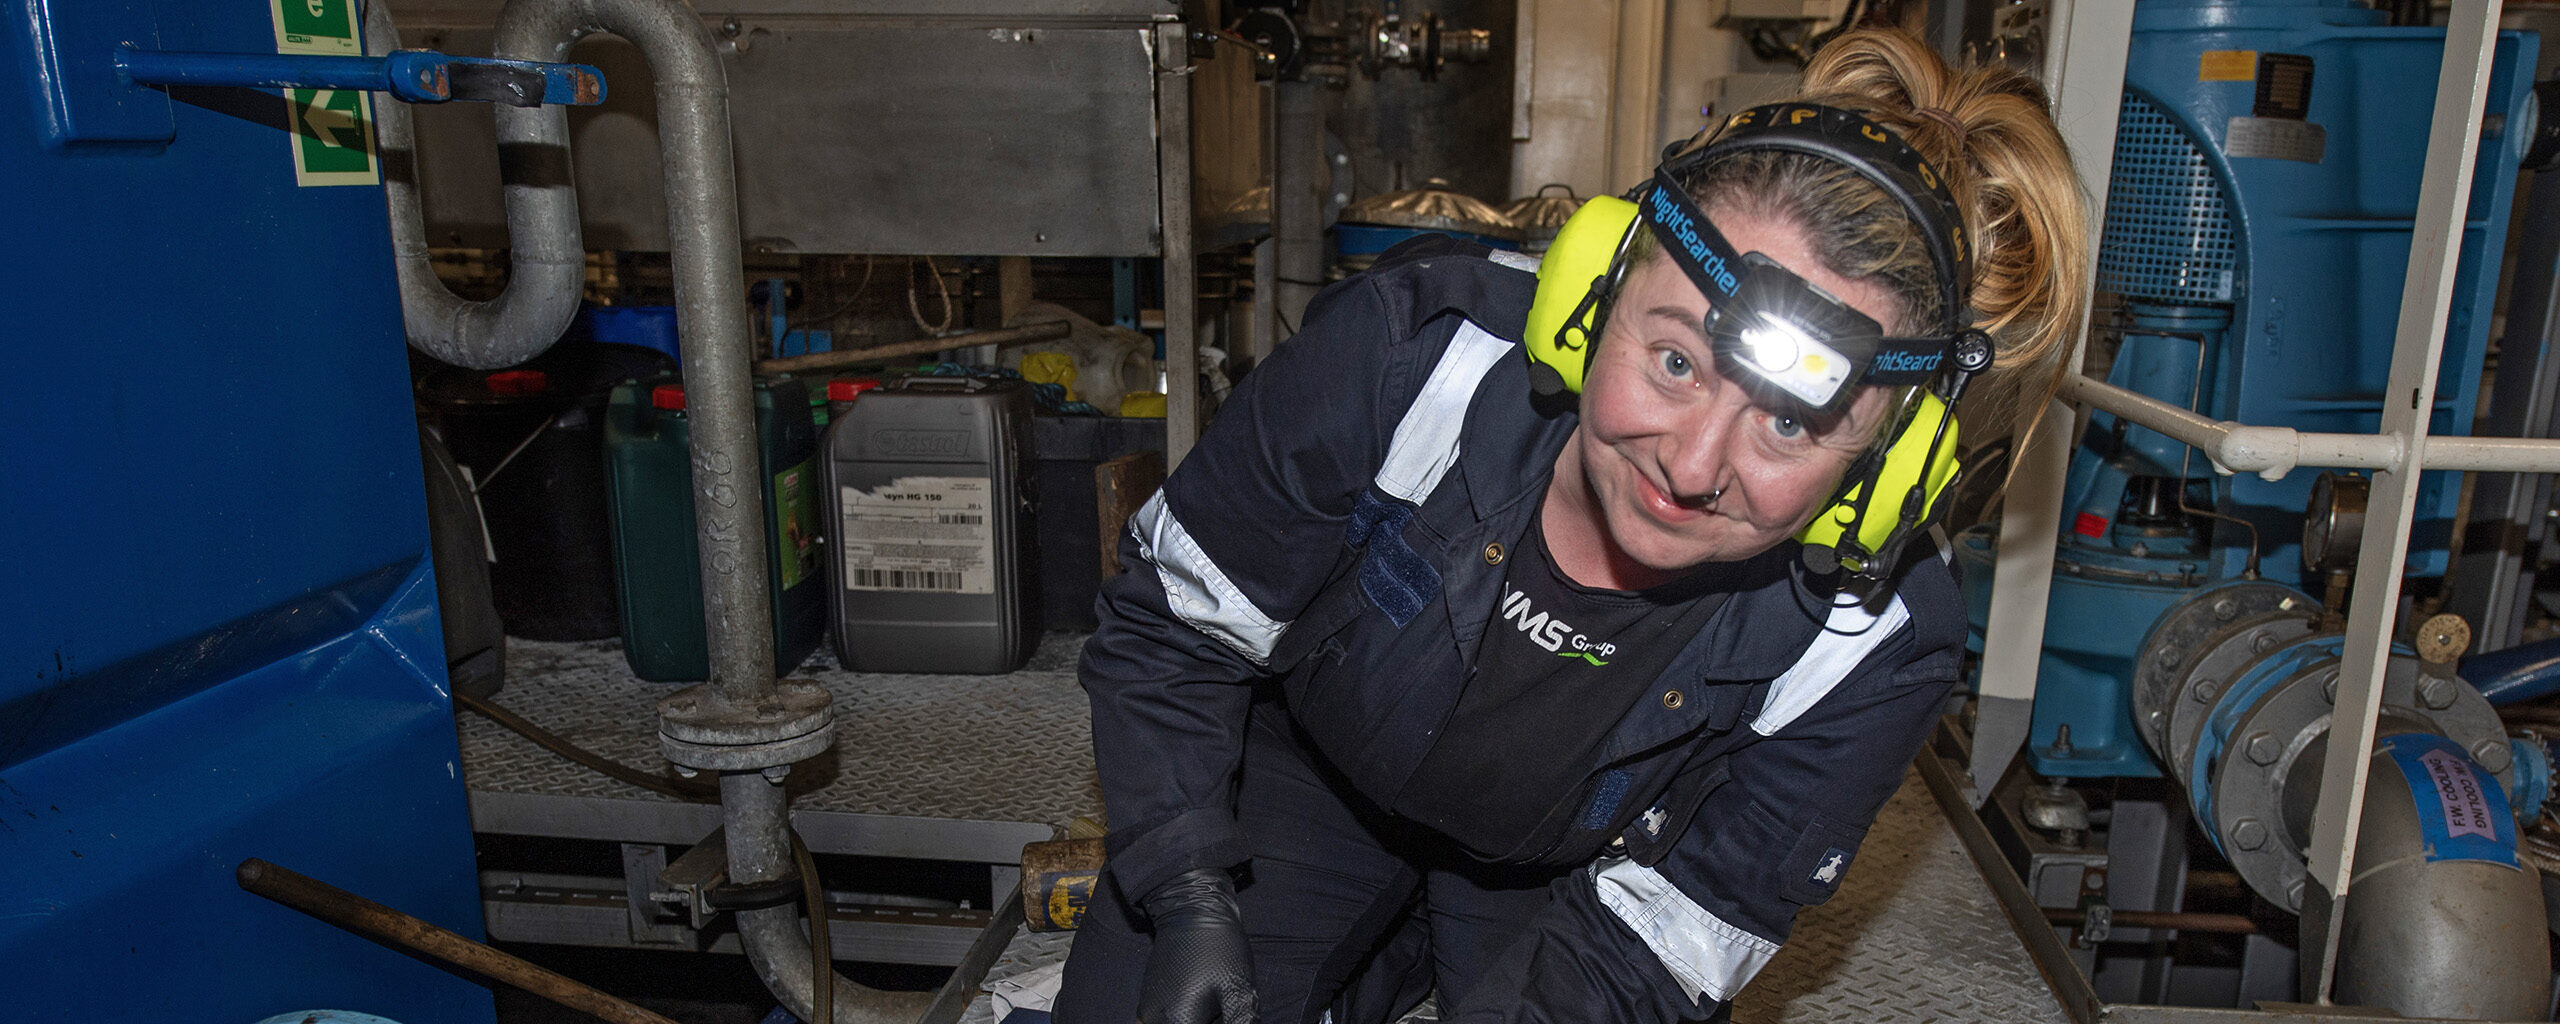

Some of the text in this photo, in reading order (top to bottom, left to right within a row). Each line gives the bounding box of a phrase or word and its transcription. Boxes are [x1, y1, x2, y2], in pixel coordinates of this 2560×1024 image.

[907, 492, 921, 501] HG
[925, 493, 942, 502] 150
[1571, 634, 1617, 657] Grup
[2429, 758, 2458, 801] COOLING
[2460, 779, 2487, 829] COOLING
